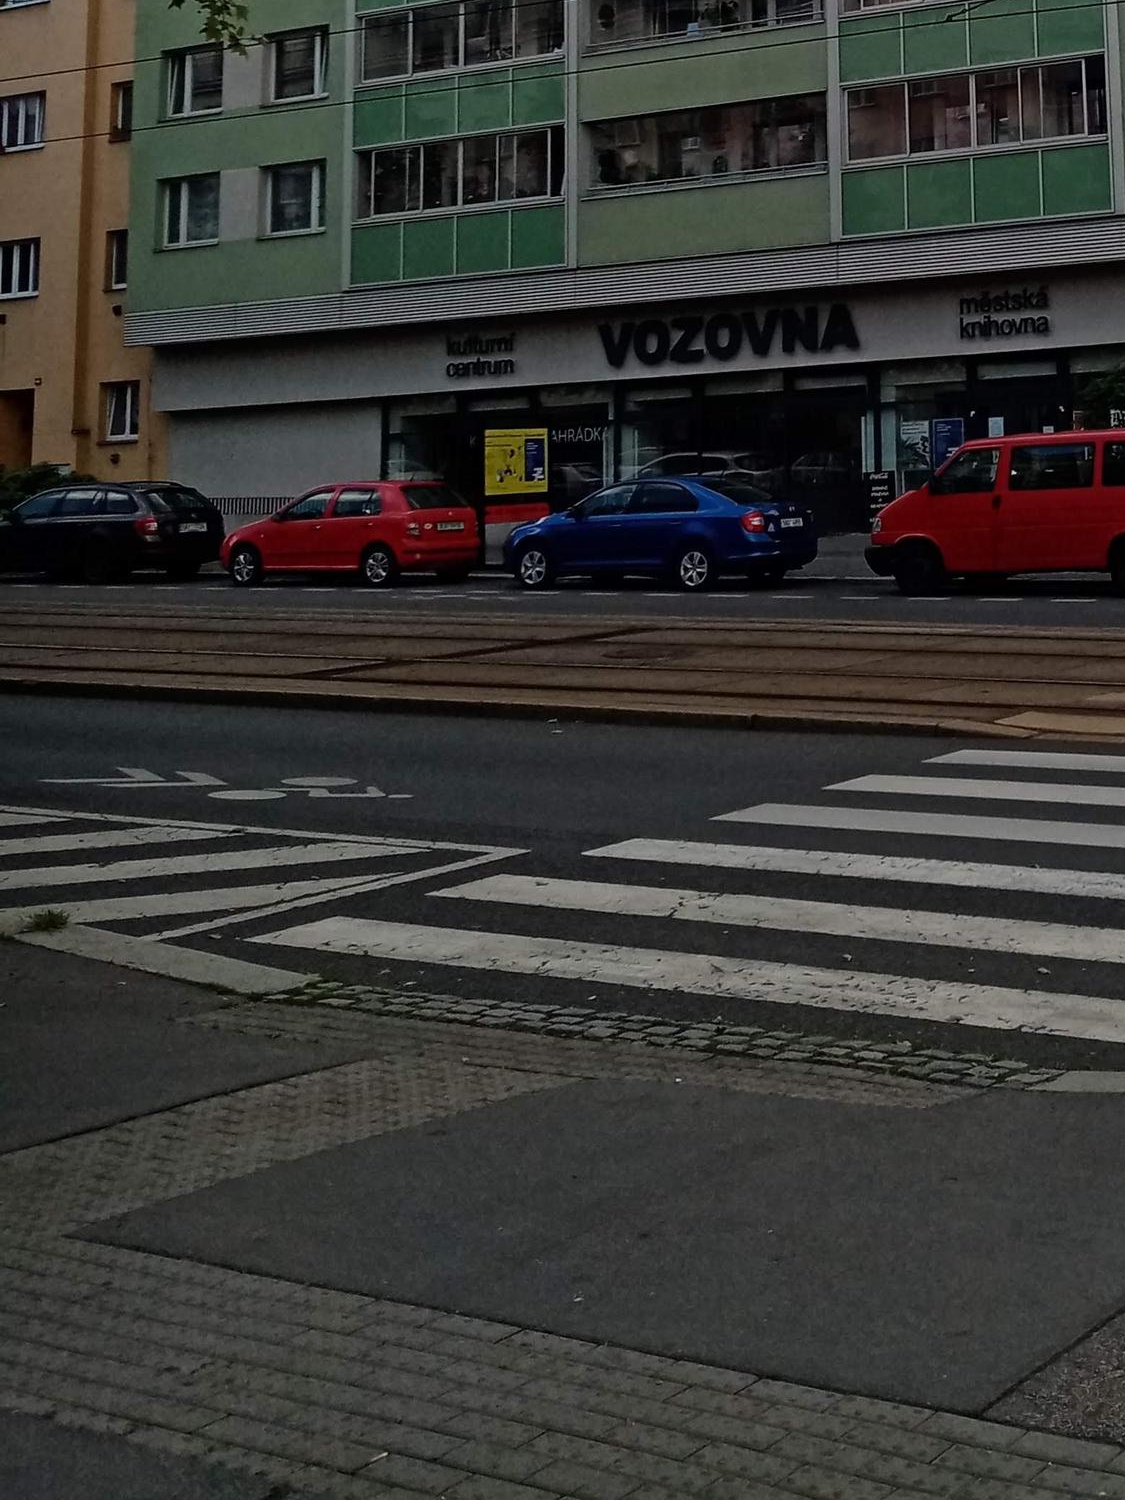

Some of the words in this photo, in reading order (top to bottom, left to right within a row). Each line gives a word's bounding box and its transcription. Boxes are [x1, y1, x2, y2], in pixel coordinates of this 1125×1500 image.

[960, 286, 1048, 314] městská
[598, 303, 860, 369] VOZOVNA
[960, 315, 1049, 339] knihovna
[447, 332, 516, 356] kulturní
[446, 358, 515, 377] centrum
[551, 424, 609, 443] AHRÁDKA
